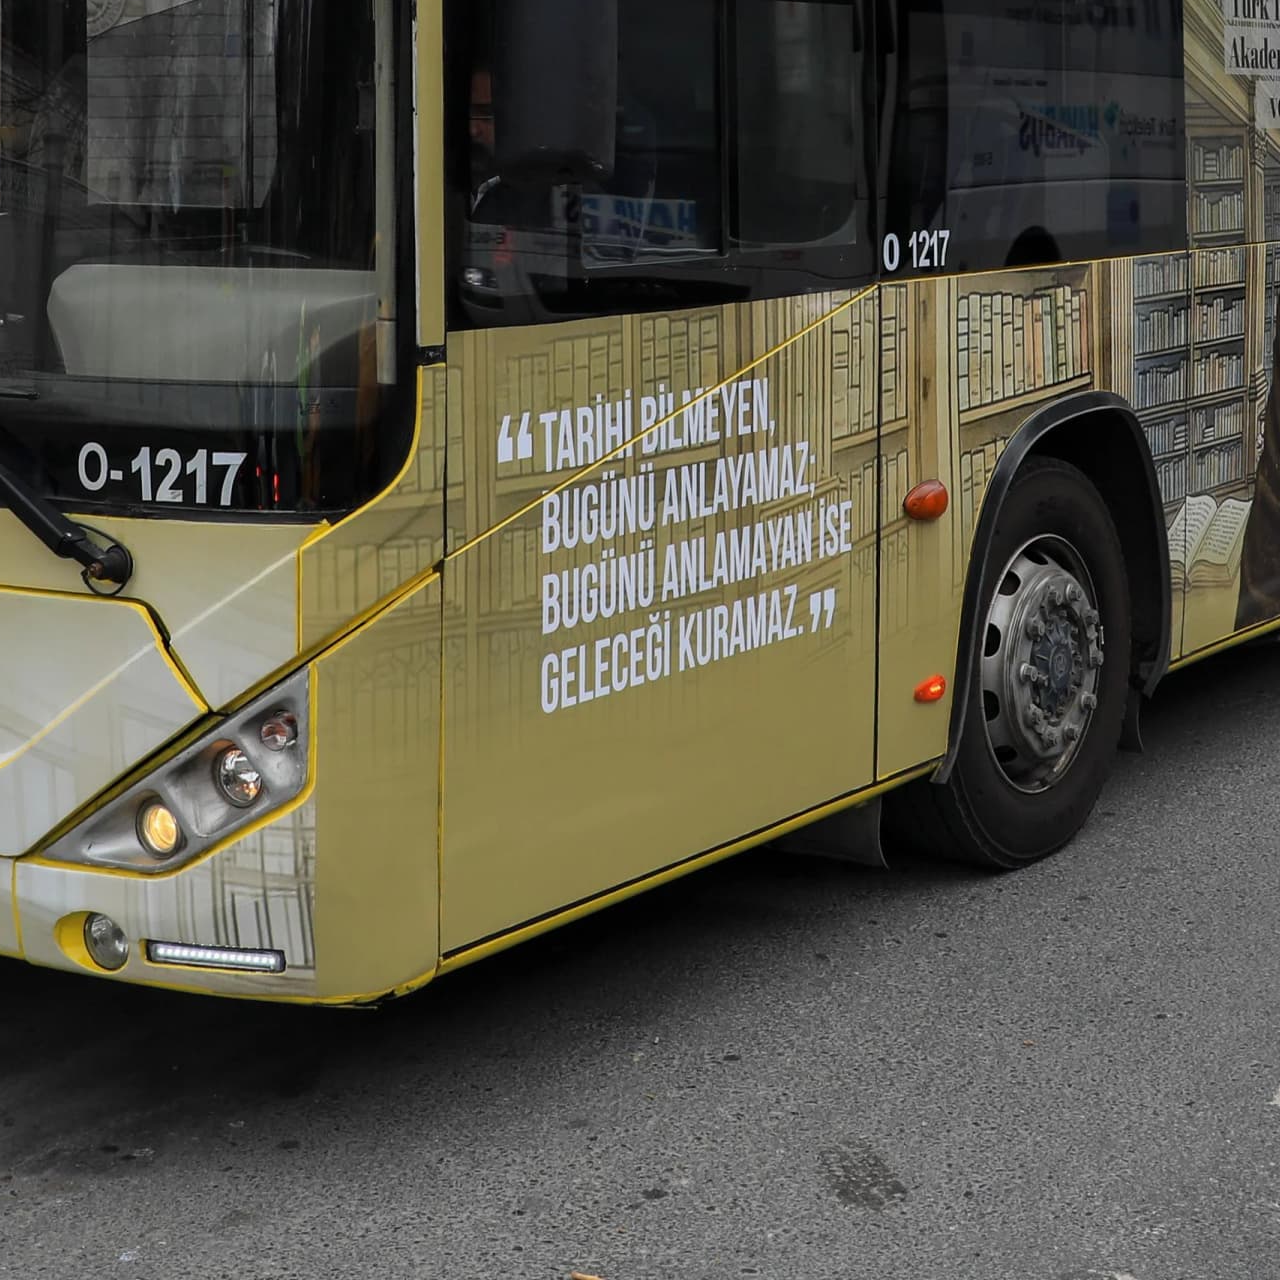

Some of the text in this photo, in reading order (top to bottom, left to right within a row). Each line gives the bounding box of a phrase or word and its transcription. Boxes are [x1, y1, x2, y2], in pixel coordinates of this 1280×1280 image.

[908, 229, 950, 269] 1217
[640, 376, 776, 455] BİLMEYEN,
[77, 441, 248, 507] O-1217
[541, 441, 817, 555] BUGÜNÜ ANLAYAMAZ;
[541, 496, 853, 635] BUGÜNÜ ANLAMAYAN İSE
[540, 613, 672, 715] GELECEĞİ
